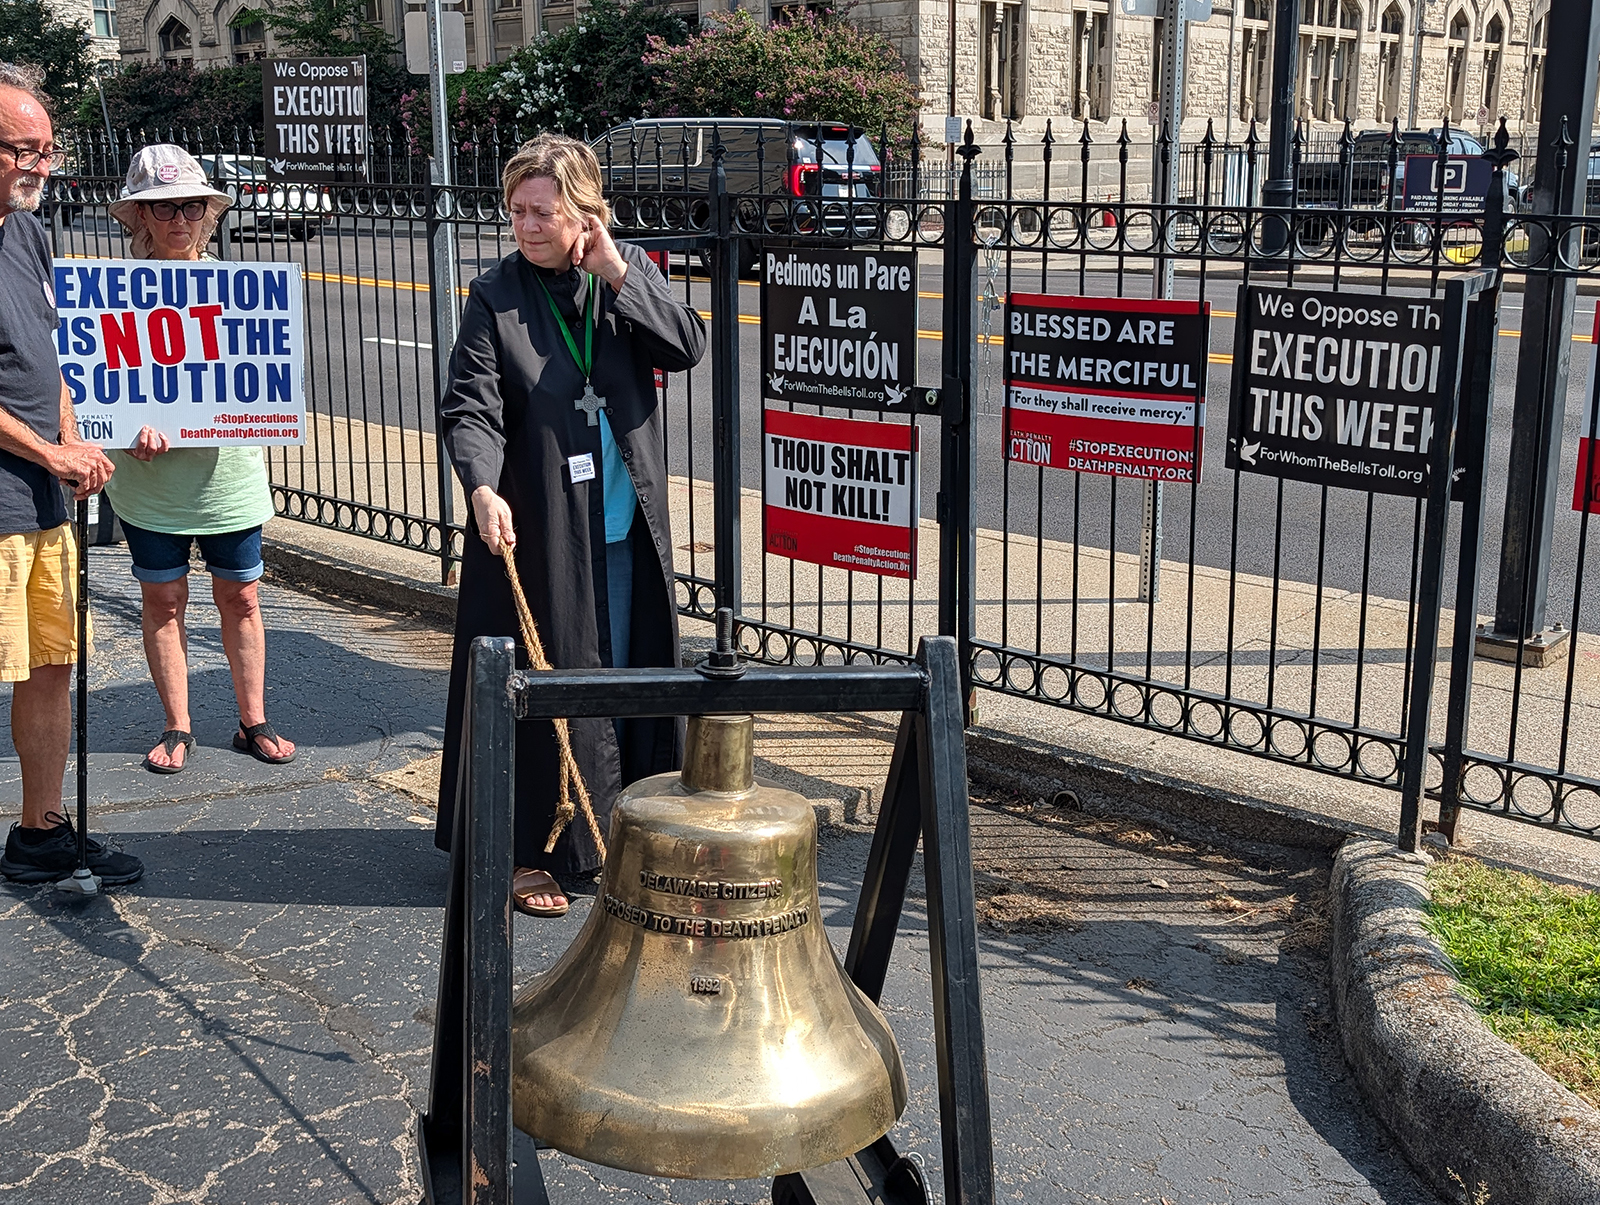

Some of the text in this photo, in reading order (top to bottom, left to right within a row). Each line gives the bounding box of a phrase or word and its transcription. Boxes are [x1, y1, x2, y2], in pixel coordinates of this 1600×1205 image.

[274, 62, 296, 77] We
[300, 61, 348, 80] Oppose
[273, 85, 364, 116] EXECUTIO
[276, 124, 320, 154] THIS
[1444, 168, 1456, 185] P
[766, 252, 911, 291] Pedimos un Pare
[54, 267, 288, 311] EXECUTION
[798, 296, 867, 329] A La
[1258, 292, 1441, 330] We Oppose Th
[57, 304, 291, 369] IS NOT THE
[1010, 311, 1175, 346] BLESSED ARE
[774, 331, 899, 381] EJECUCIÓN
[1010, 351, 1197, 389] THE MERCIFUL
[60, 362, 292, 404] SOLUTION
[784, 379, 884, 402] ForWhomTheBellsToll.org
[213, 413, 298, 425] #StopExecutions
[1034, 395, 1058, 412] they
[1061, 396, 1088, 412] shall
[1092, 402, 1136, 416] receive
[1250, 387, 1325, 441] THIS
[180, 428, 299, 440] DeathPenaltyAction.org
[1026, 433, 1052, 441] PENALTY
[771, 436, 910, 486] THOU SHALT
[1260, 447, 1423, 484] ForWhomTheBellsToll.org
[785, 475, 890, 522] NOT KILL!
[640, 870, 783, 899] DELAWARE CITIZENS
[652, 914, 671, 932] TO
[676, 919, 705, 937] THE
[711, 919, 761, 938] DEATH
[690, 977, 721, 992] 1992
